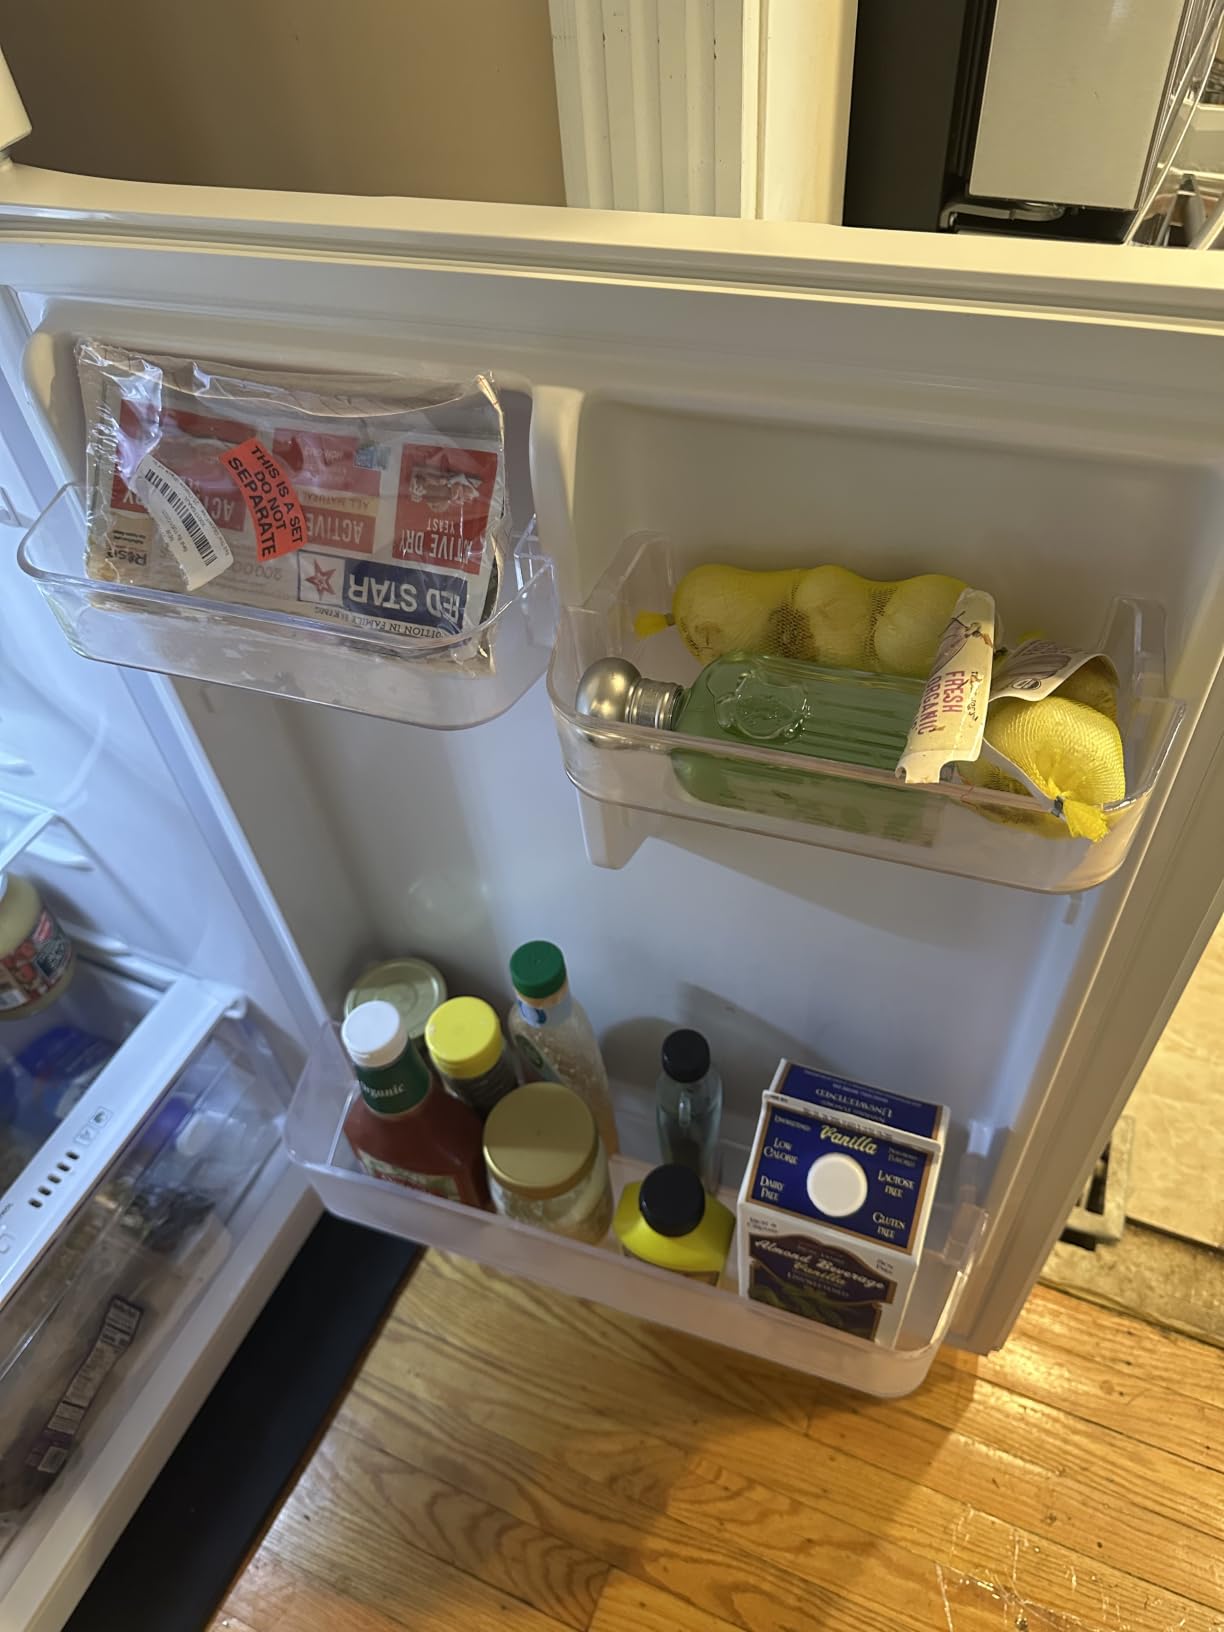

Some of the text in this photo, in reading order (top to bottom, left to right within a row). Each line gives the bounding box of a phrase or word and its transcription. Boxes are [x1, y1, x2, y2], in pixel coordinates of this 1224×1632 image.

[228, 457, 277, 557] SEPARATE
[251, 446, 303, 543] THIS IS A SET
[254, 471, 287, 530] DO NOT
[306, 513, 365, 545] ACTIVE
[400, 529, 425, 556] DRY
[426, 517, 456, 534] YEAST
[348, 573, 419, 613] STAR
[351, 613, 389, 631] FAMILY
[389, 624, 404, 633] IN
[917, 675, 942, 736] ORGANIC
[942, 670, 966, 713] FRESH
[819, 1125, 879, 1156] Vanilla
[754, 1239, 814, 1264] Almond
[815, 1257, 886, 1290] Beverage
